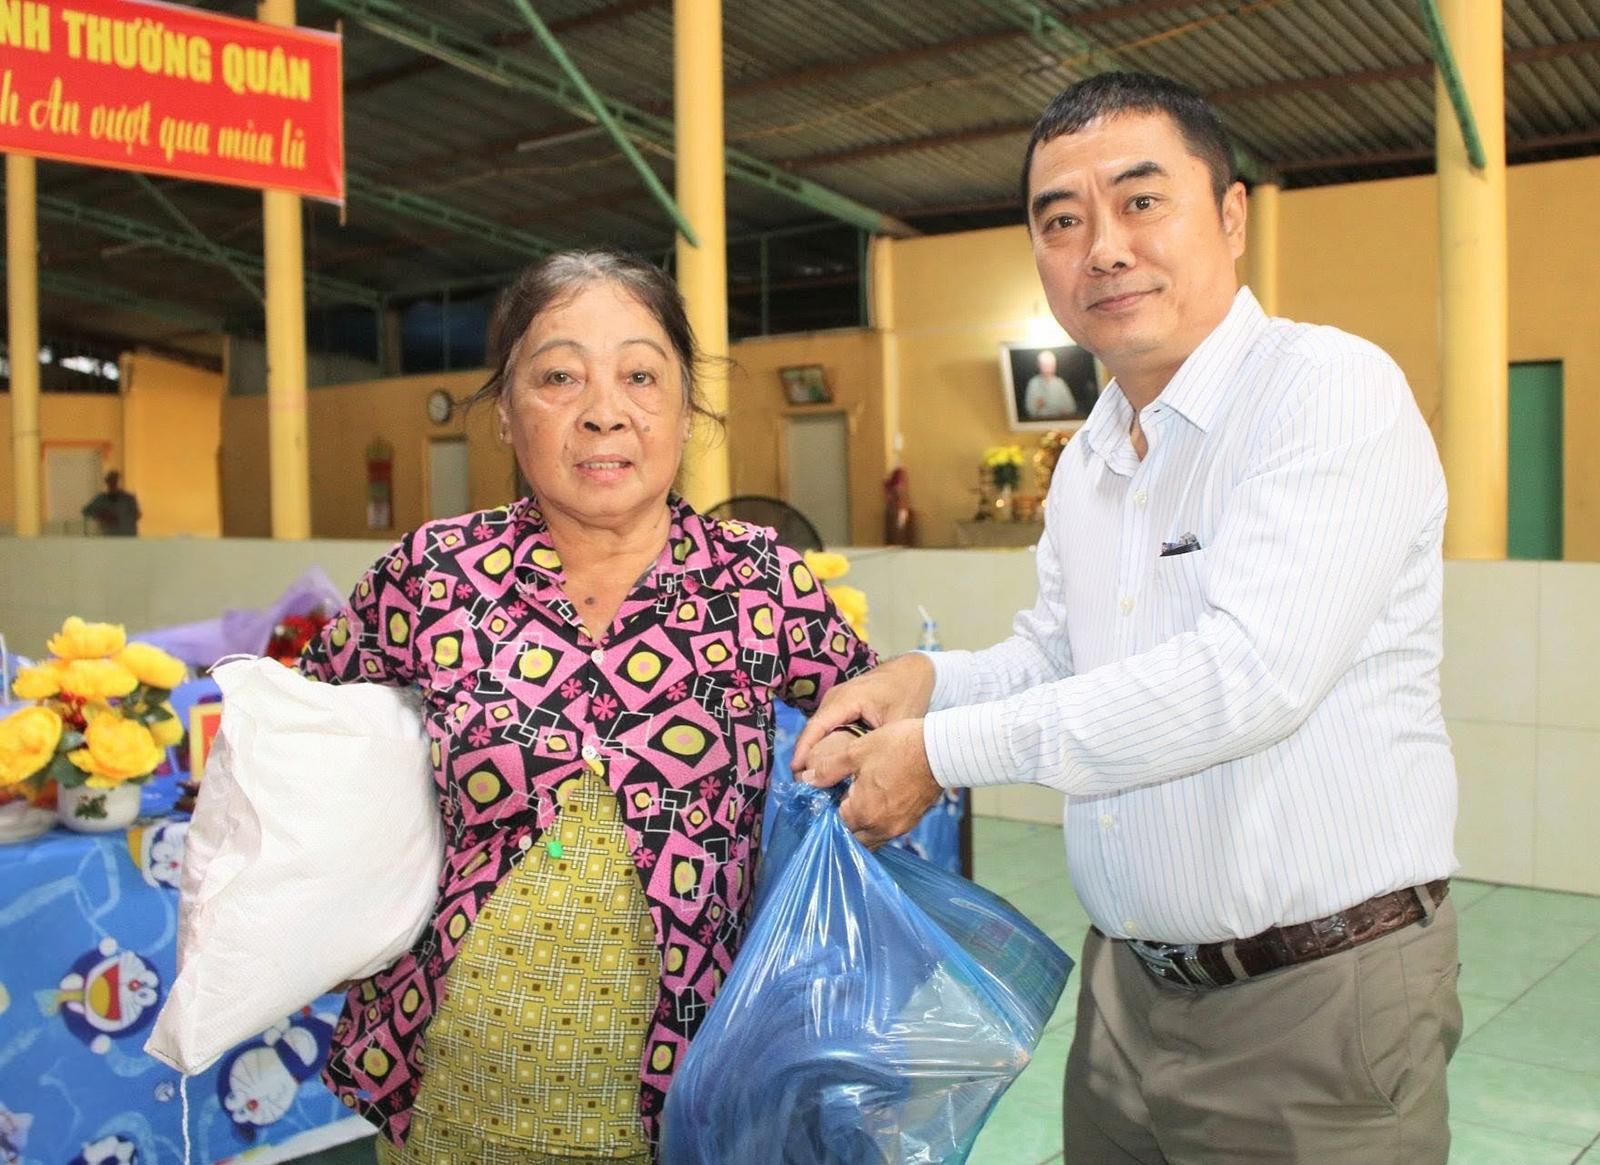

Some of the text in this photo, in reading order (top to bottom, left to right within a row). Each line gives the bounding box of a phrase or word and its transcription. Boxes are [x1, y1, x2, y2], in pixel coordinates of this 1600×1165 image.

[62, 8, 212, 84] THƯỜNG
[222, 43, 311, 101] QUÂN
[29, 76, 81, 136] An
[90, 101, 150, 156] vượt
[159, 116, 210, 163] qua
[217, 119, 274, 165] mùa
